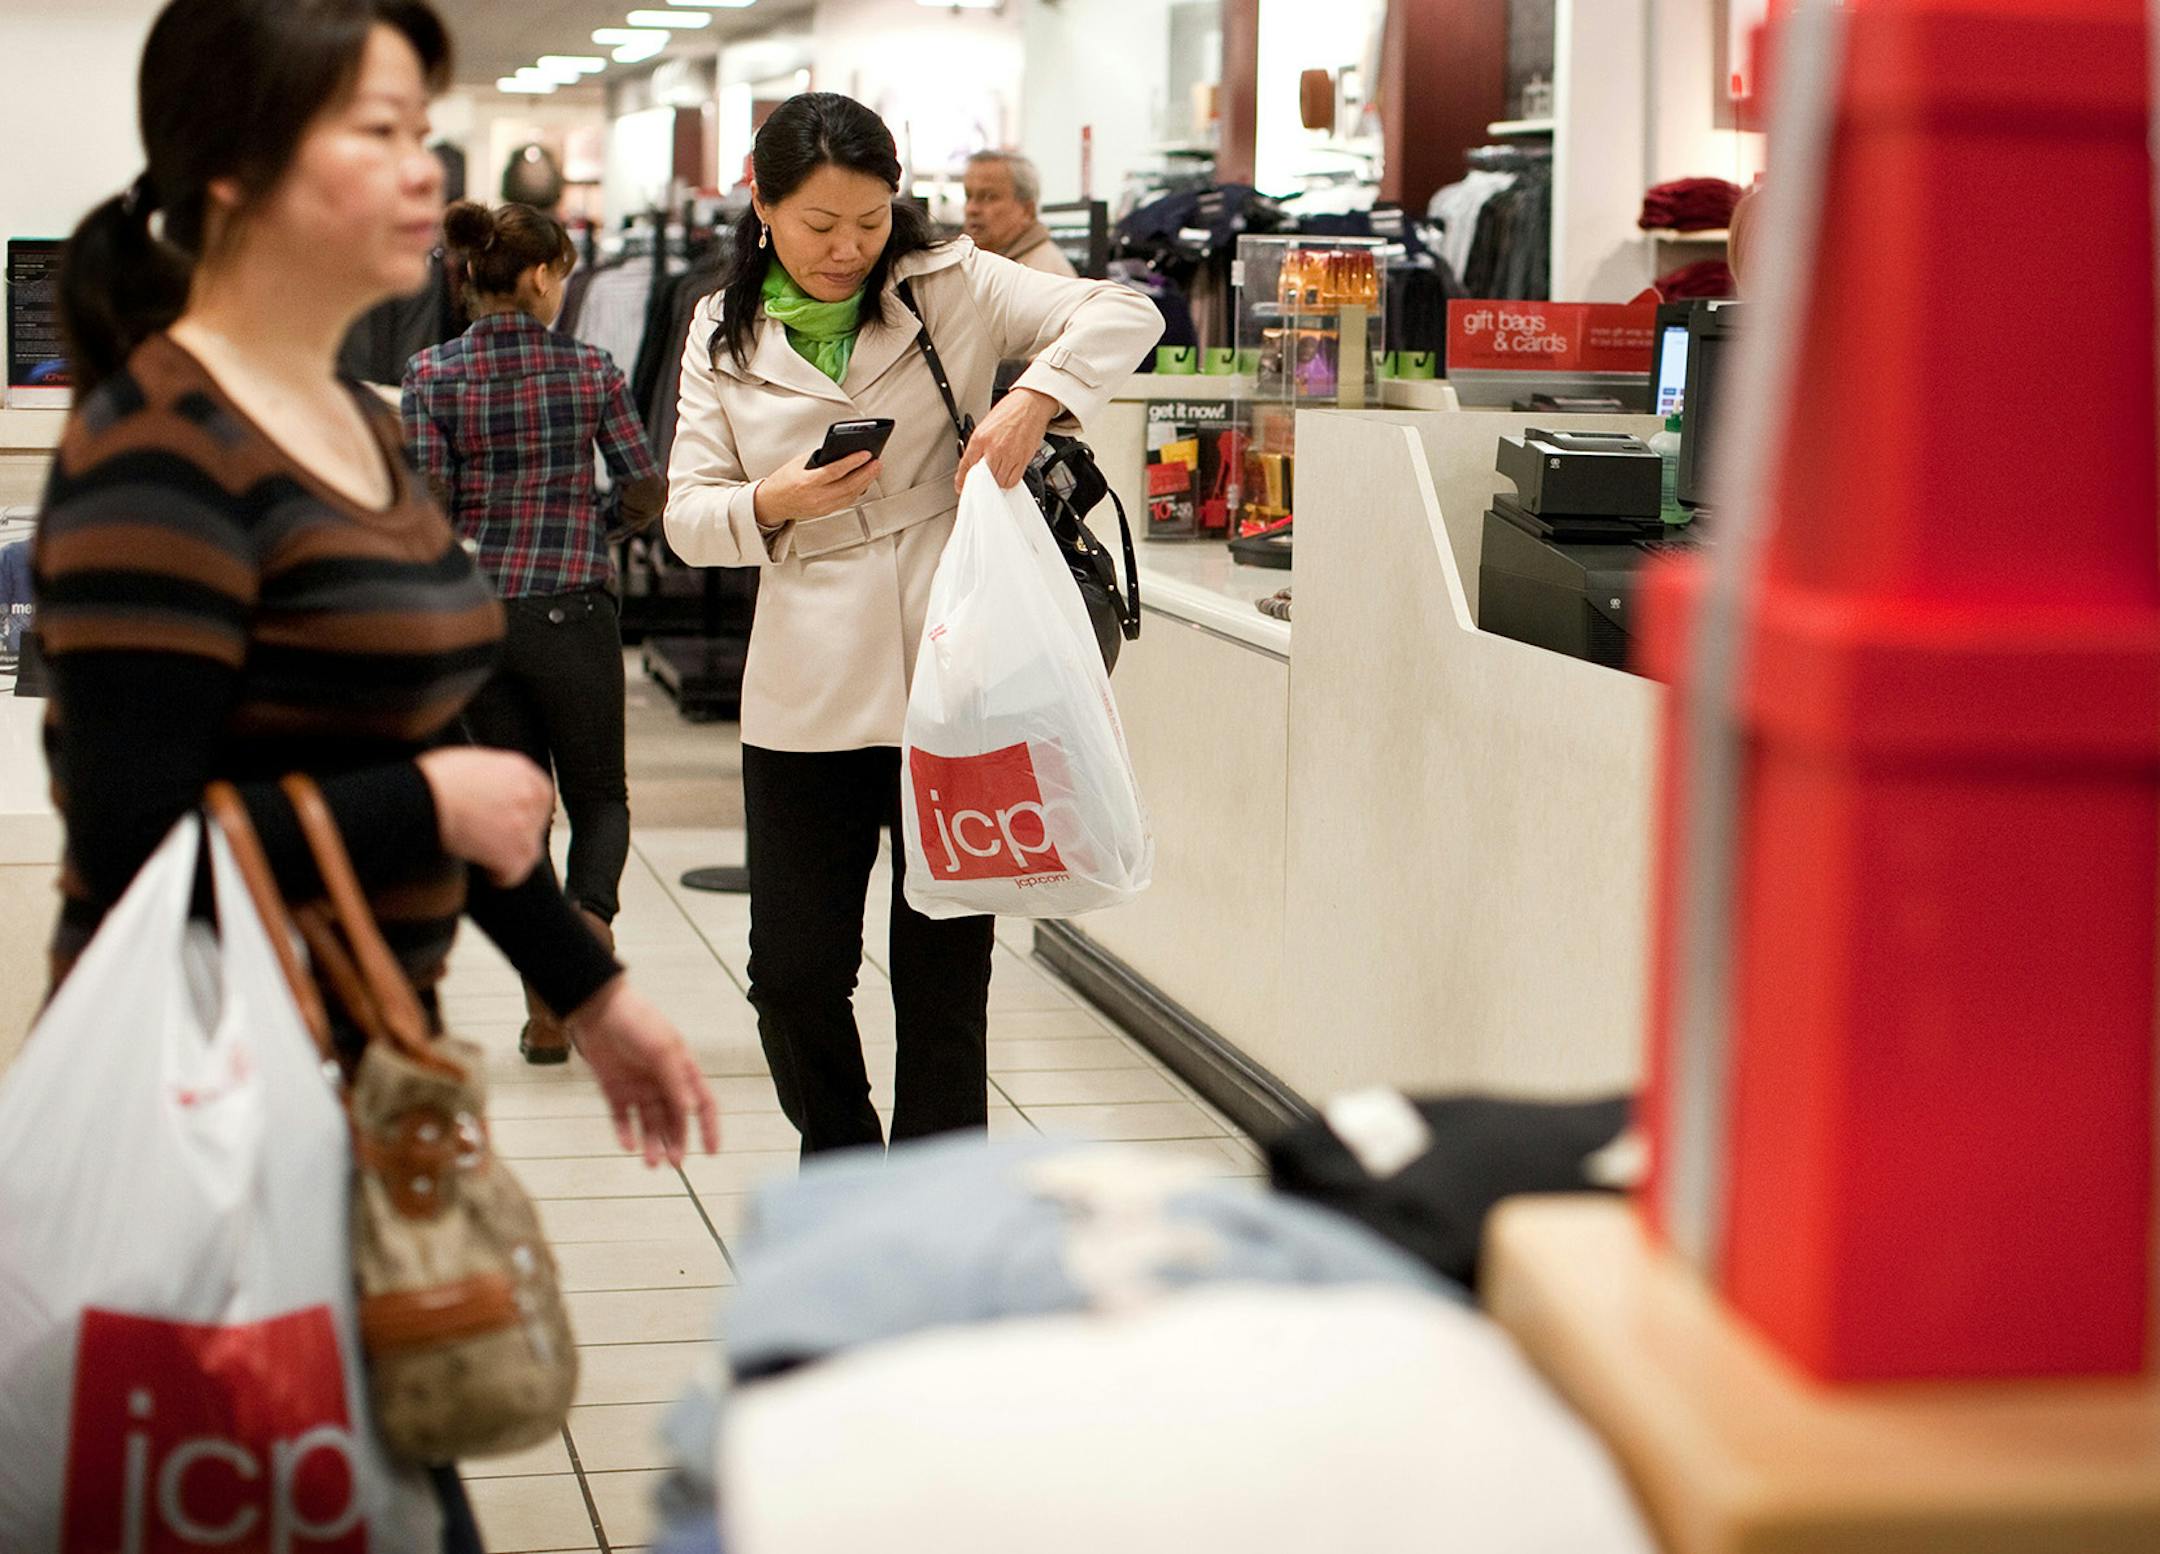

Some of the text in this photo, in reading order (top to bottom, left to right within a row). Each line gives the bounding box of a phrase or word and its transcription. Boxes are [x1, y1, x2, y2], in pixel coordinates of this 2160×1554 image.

[1463, 310, 1546, 336] gift bags
[1493, 332, 1509, 352] &
[1512, 333, 1568, 353] cards
[1149, 402, 1226, 421] get it now!
[11, 602, 35, 614] me
[929, 788, 1053, 873] jcp
[1014, 873, 1070, 888] jcp.com
[121, 1387, 362, 1554] jcp
